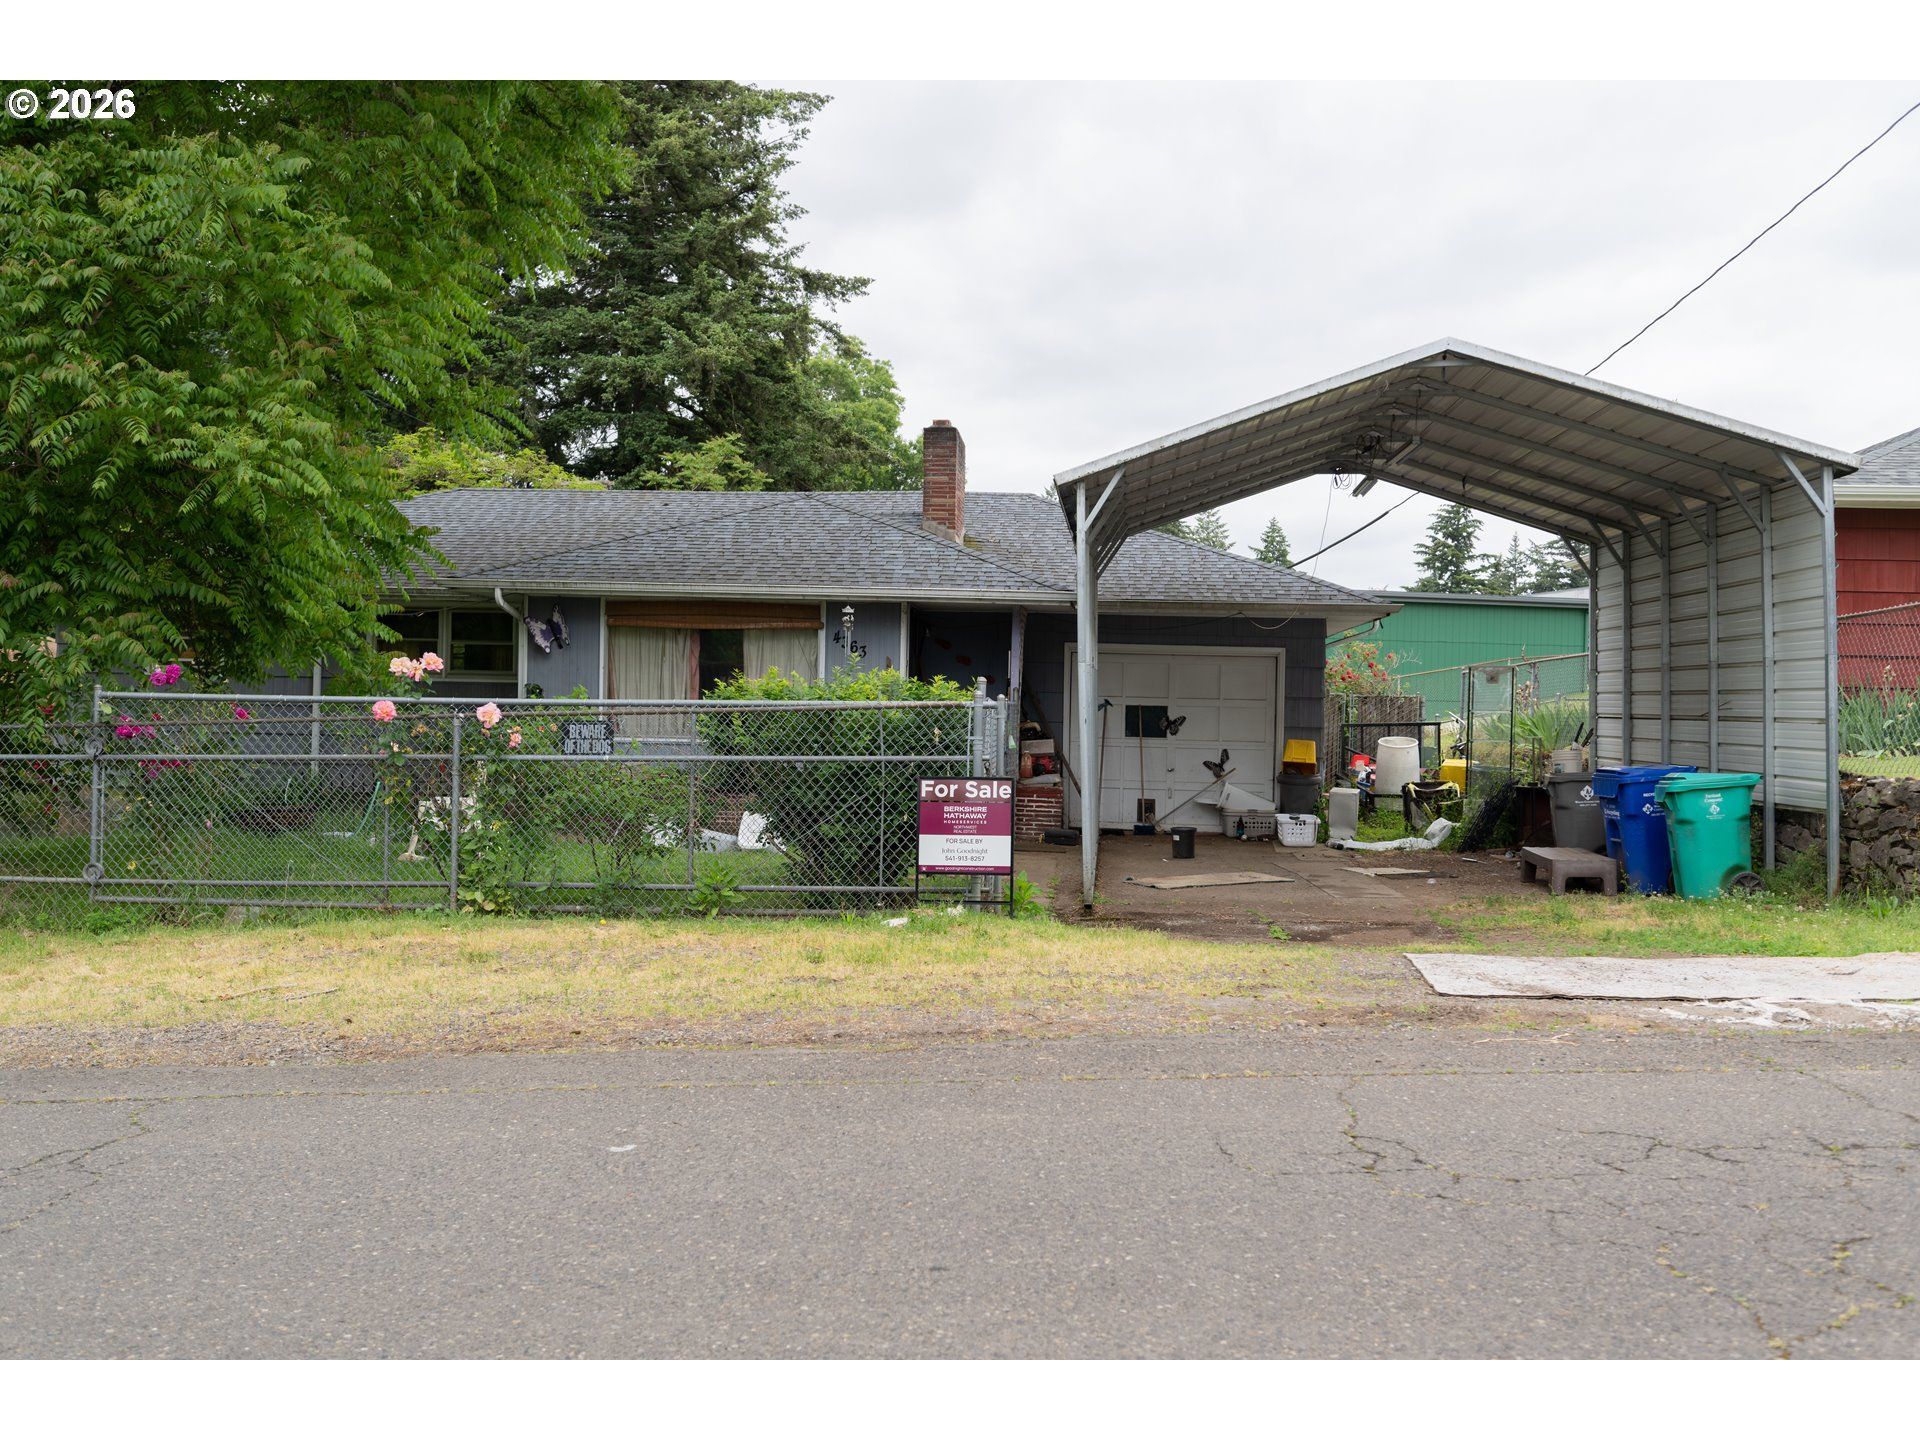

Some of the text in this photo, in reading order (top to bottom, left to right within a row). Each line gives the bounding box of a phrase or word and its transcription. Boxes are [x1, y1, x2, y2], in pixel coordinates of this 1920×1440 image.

[569, 724, 607, 739] BEWARE
[564, 739, 611, 754] OF THE DOG
[921, 780, 1012, 798] For Sale
